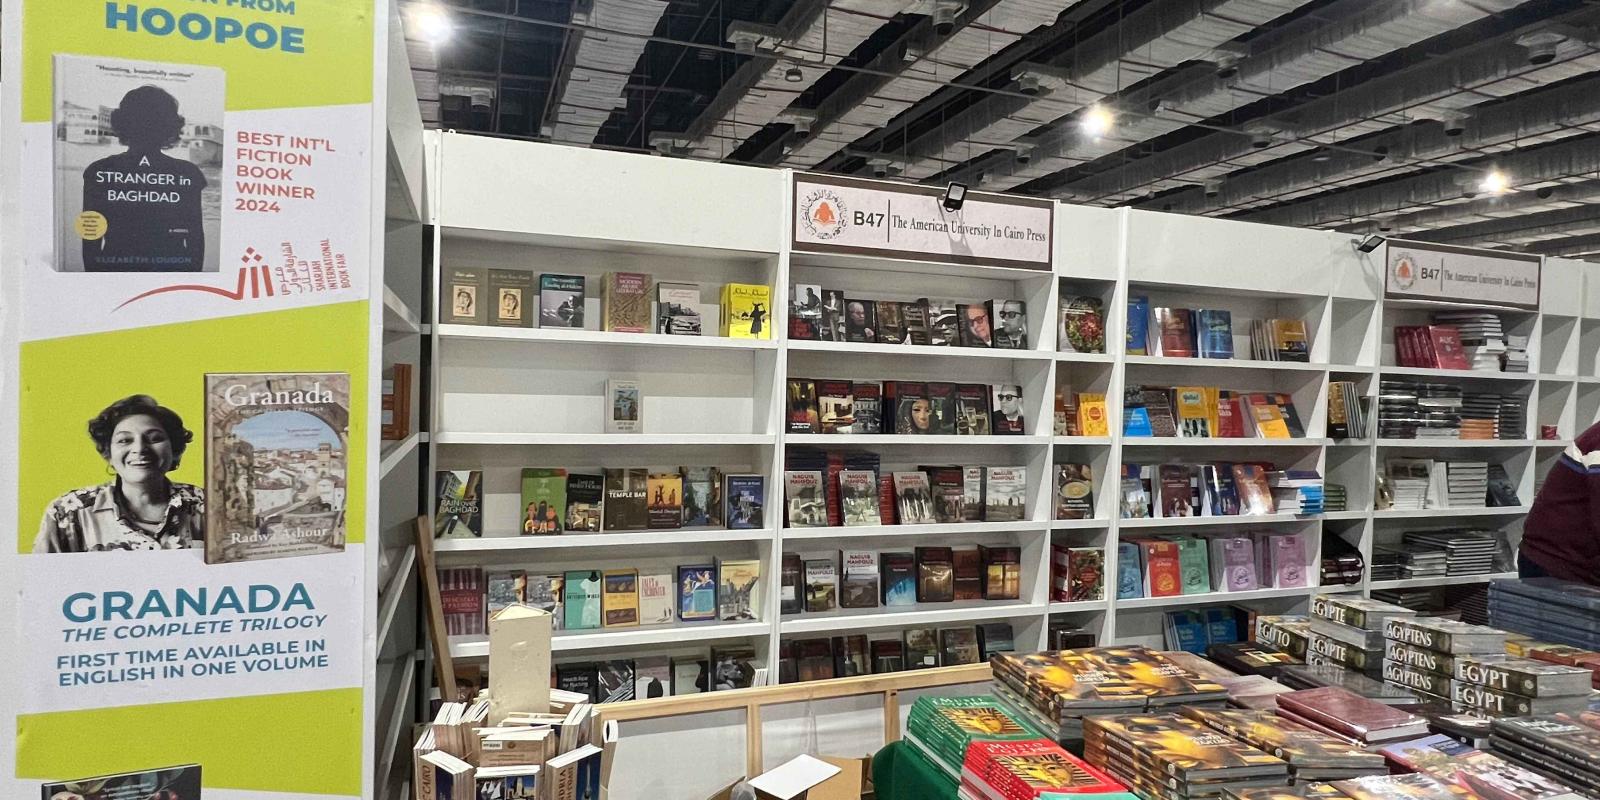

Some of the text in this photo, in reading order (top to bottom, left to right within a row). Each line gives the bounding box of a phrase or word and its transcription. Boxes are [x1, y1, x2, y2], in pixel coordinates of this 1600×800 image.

[105, 2, 305, 54] HOOPOE
[237, 131, 336, 153] BEST INT'L
[139, 155, 151, 167] A
[236, 148, 313, 167] FICTION
[96, 171, 191, 186] STRANGER in
[236, 165, 293, 182] BOOK
[107, 189, 181, 203] BAGHDAD
[235, 181, 316, 200] WINNER
[235, 198, 281, 214] 2024
[853, 210, 1047, 242] B47 The American University In Cairo Press
[312, 260, 327, 292] SHARJAH
[320, 239, 338, 290] INTERNATIONAL
[335, 253, 352, 289] BOOK FAIR
[1421, 267, 1440, 281] B47
[1443, 270, 1454, 281] The
[1455, 272, 1478, 283] American
[224, 382, 335, 407] Granada
[609, 491, 633, 499] TEMPLE
[439, 506, 479, 514] BAGHDAD
[230, 527, 329, 545] Radwa Ashour
[61, 582, 316, 623] GRANADA
[1311, 599, 1347, 624] EGYPTE
[61, 613, 328, 643] THE COMPLETE TRILOGY
[56, 638, 327, 669] FIRST TIME AVAILABLE IN
[1311, 636, 1347, 662] EGYPTE
[58, 654, 330, 687] ENGLISH IN ONE VOLUME
[1458, 663, 1511, 689] EGYPT
[1454, 685, 1506, 713] EGYPT
[421, 765, 431, 794] CAIRO
